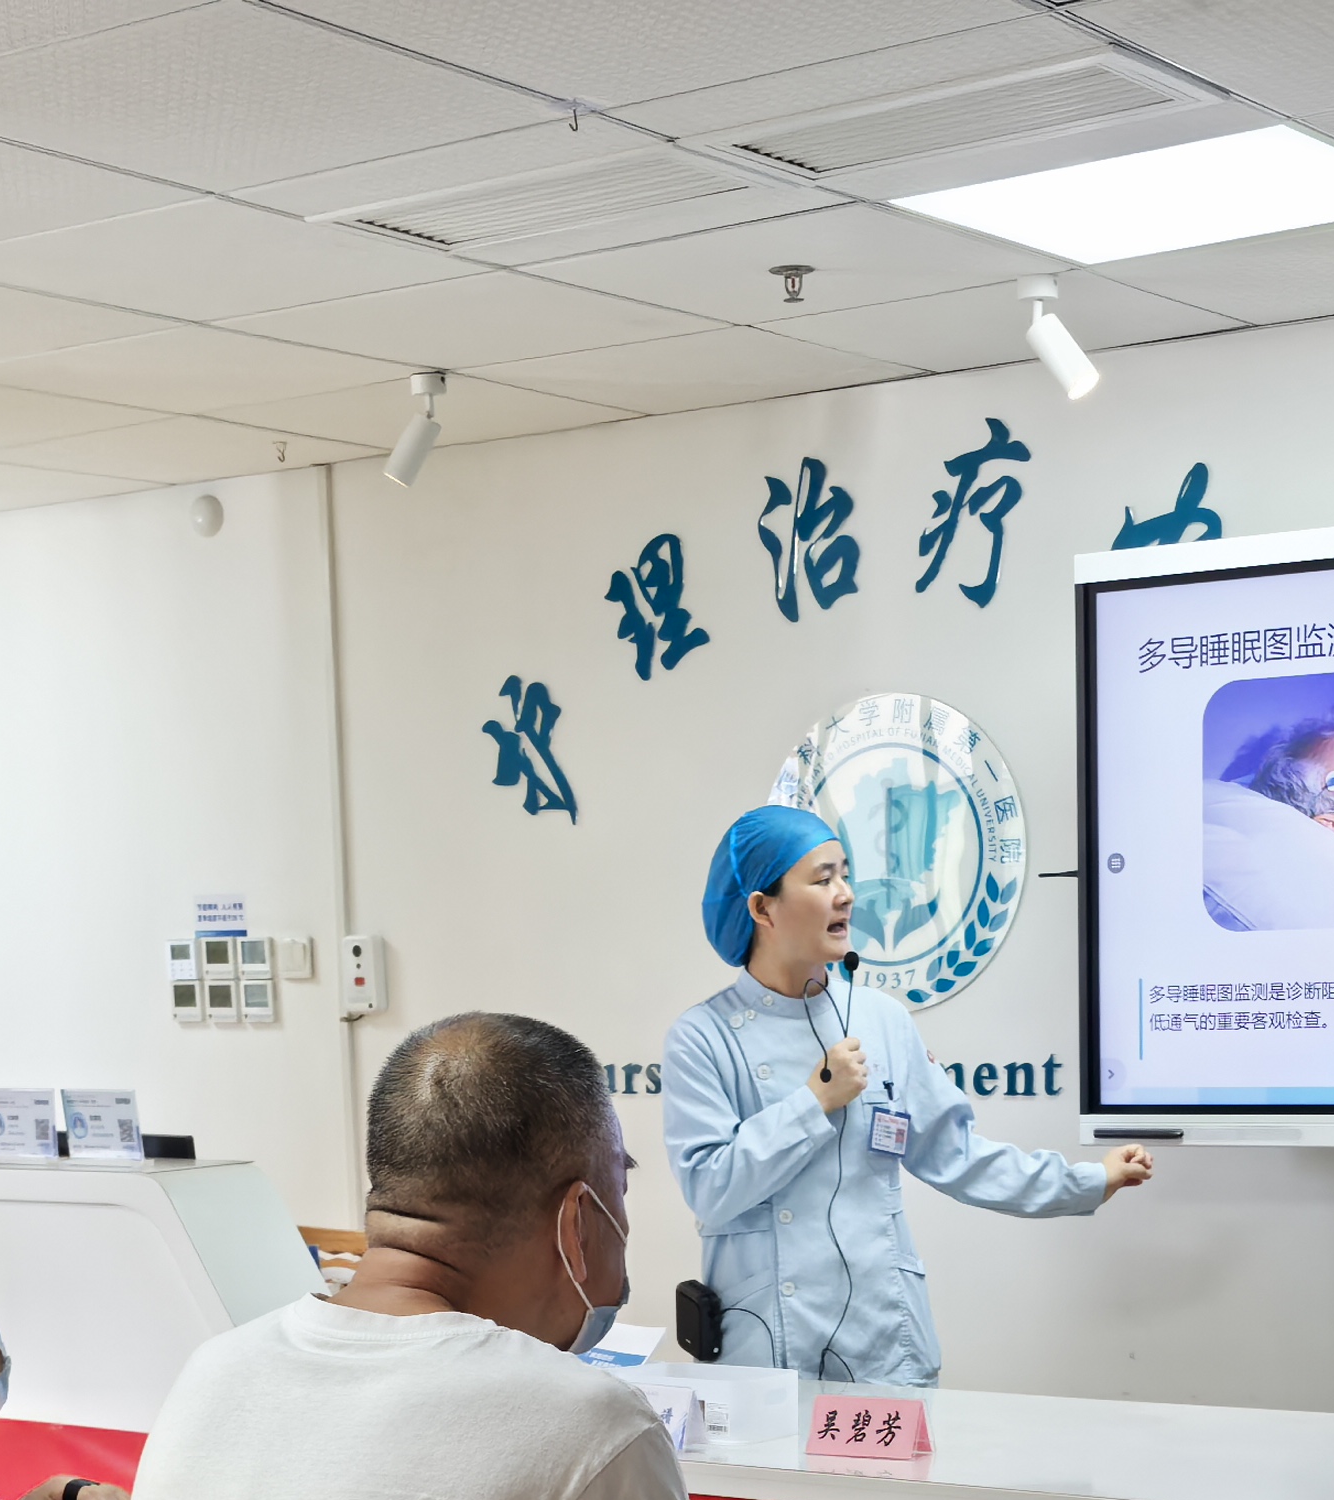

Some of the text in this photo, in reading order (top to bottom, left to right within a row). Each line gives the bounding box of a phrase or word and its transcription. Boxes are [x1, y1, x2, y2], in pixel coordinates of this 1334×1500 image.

[863, 970, 916, 988] 1937
[1149, 1010, 1329, 1032] 低通气的重要客观检查。
[817, 1410, 903, 1447] 吴碧芳
